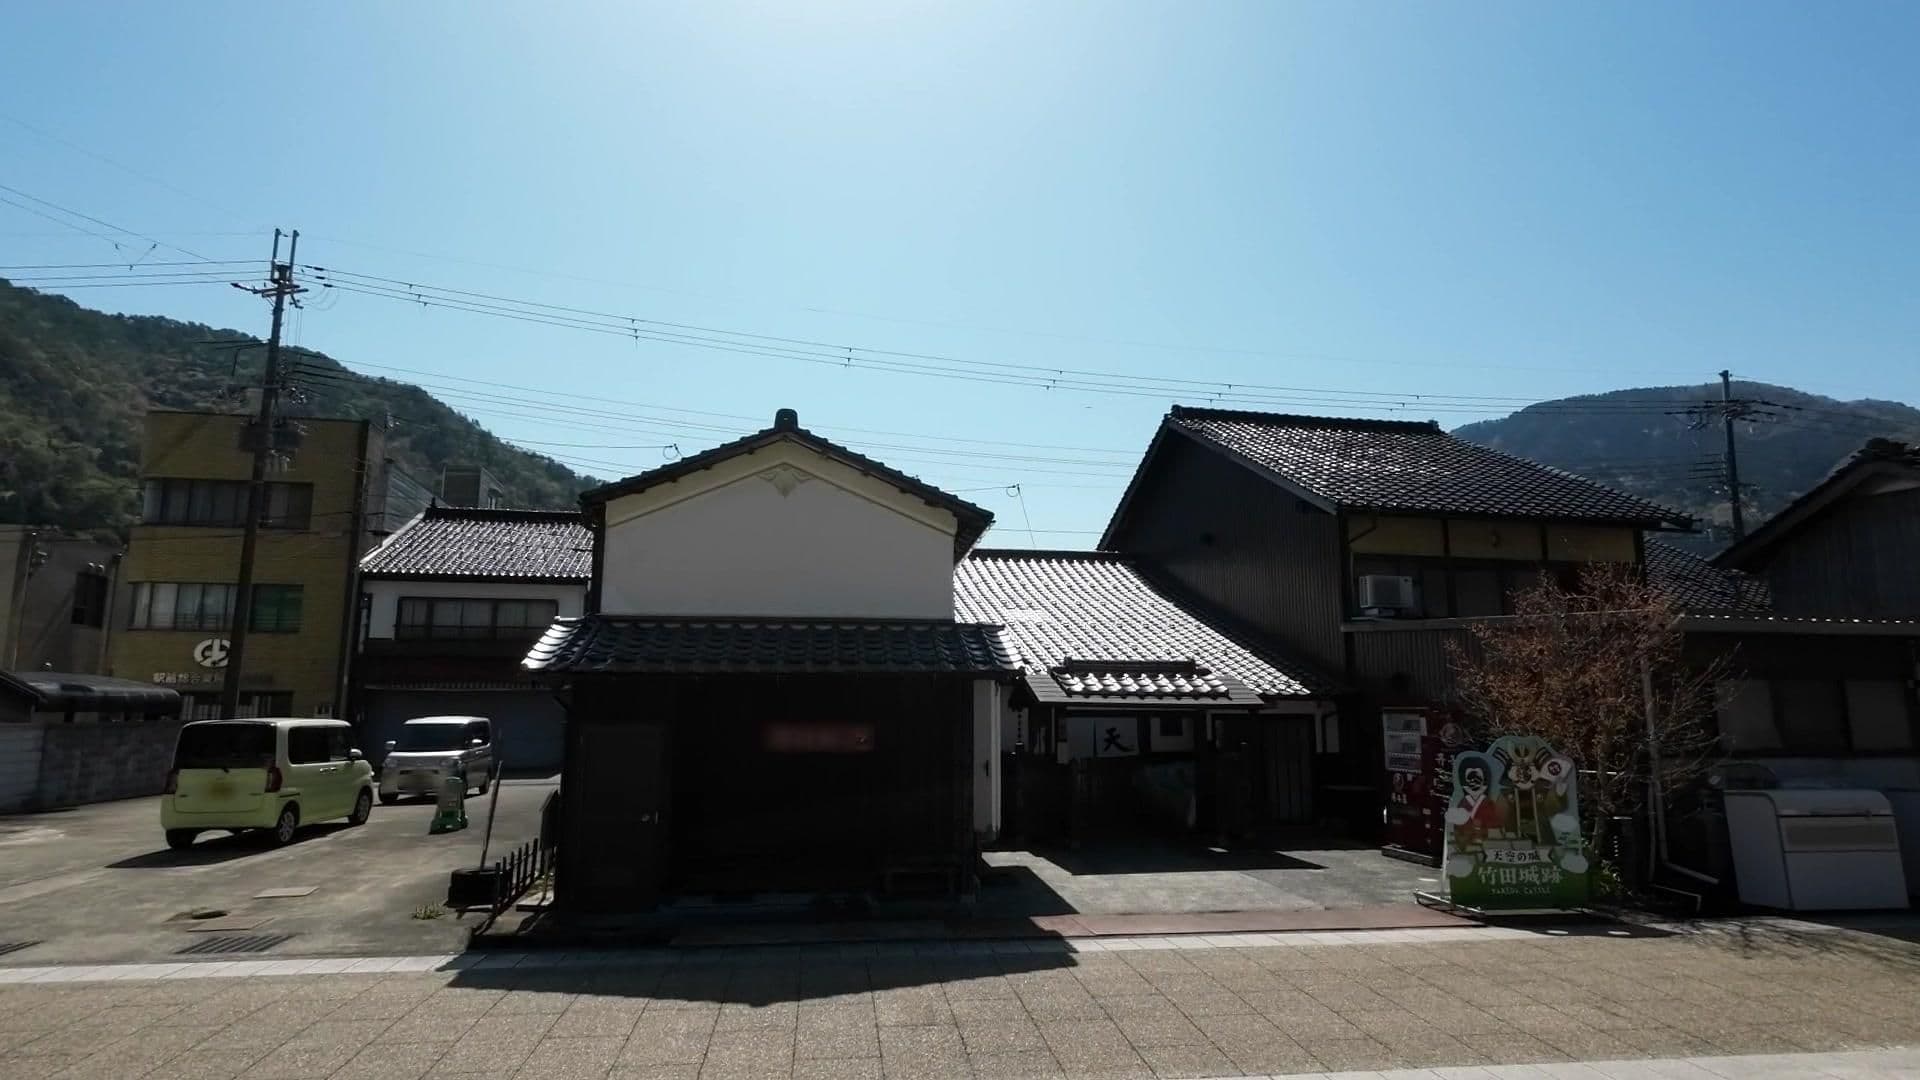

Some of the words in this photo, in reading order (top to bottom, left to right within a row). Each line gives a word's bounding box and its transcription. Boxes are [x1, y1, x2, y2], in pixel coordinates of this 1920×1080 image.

[1103, 727, 1133, 752] 天
[1478, 864, 1562, 886] 竹田城跡
